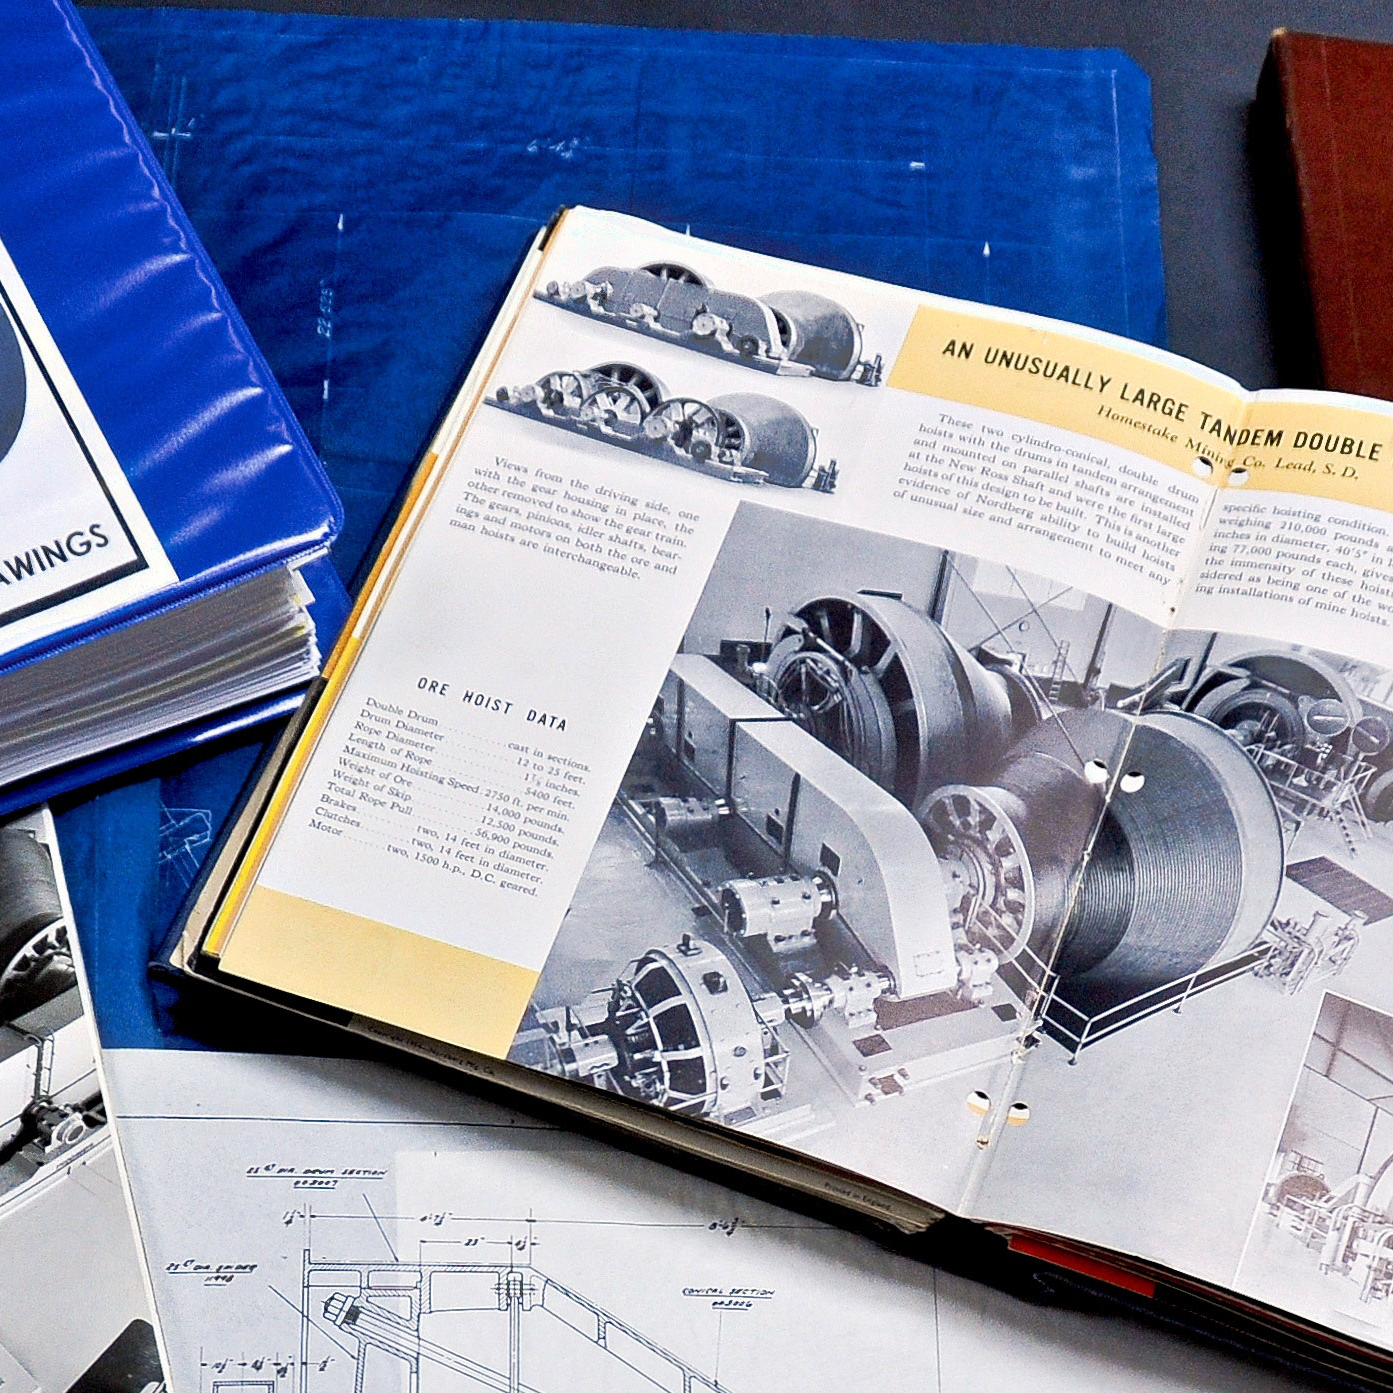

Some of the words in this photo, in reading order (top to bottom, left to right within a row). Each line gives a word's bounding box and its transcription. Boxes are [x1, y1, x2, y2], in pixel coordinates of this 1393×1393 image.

[942, 339, 974, 359] AN
[984, 347, 1112, 393] UNUSUALLY
[1120, 383, 1189, 422] LARGE
[1200, 411, 1284, 447] TANDEM
[1293, 431, 1383, 461] DOUBLE
[1097, 405, 1178, 442] Homestake
[1186, 438, 1235, 470] Mining
[1239, 456, 1265, 471] Co.
[1275, 457, 1316, 474] Lead,
[1322, 463, 1336, 476] S.
[1341, 466, 1358, 480] D.
[495, 456, 528, 474] Views
[534, 468, 563, 483] from
[570, 479, 589, 491] the
[595, 487, 640, 506] driving
[645, 500, 671, 515] side,
[678, 511, 700, 522] one
[1219, 517, 1272, 530] weighing
[1280, 521, 1327, 536] 210,000
[1333, 532, 1379, 549] pounds
[366, 697, 404, 716] Double
[407, 709, 438, 726] Drum
[508, 743, 529, 754] cast
[533, 747, 543, 758] in
[547, 754, 591, 772] sections.
[417, 677, 450, 696] ORE
[463, 690, 513, 714] HOIST
[526, 709, 566, 731] DATA
[360, 709, 391, 726] Drum
[395, 719, 445, 741] Diameter
[517, 757, 530, 767] 12
[532, 763, 544, 771] to
[547, 766, 560, 776] 25
[563, 771, 586, 785] feet.
[308, 818, 343, 836] Motor
[387, 844, 409, 858] two,
[415, 852, 440, 866] 1500
[442, 860, 465, 876] h.p.,
[470, 869, 495, 884] D.C.
[499, 880, 538, 897] geared.
